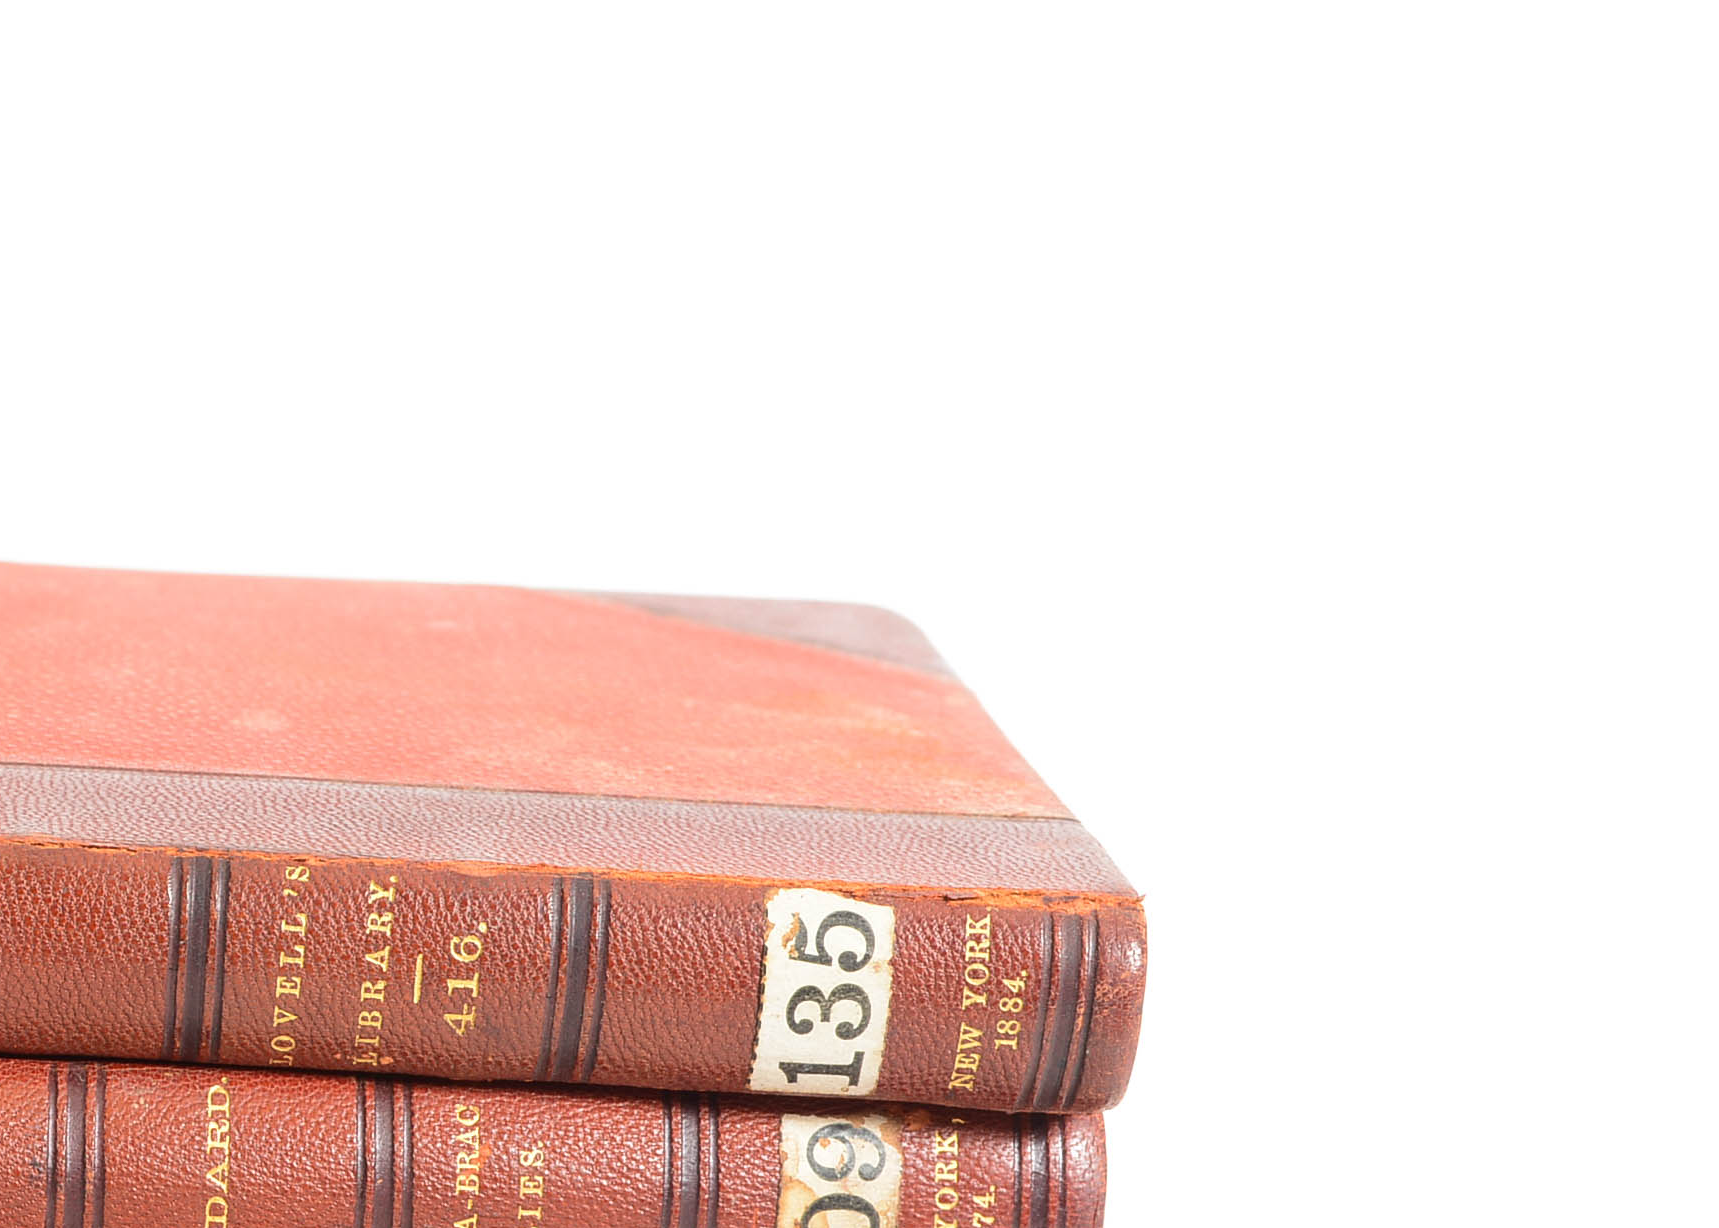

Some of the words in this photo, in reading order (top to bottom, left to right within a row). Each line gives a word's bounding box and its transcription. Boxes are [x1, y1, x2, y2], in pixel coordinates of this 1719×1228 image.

[268, 865, 310, 1067] LOVELL'S
[352, 875, 399, 1067] LIBRARY.
[443, 921, 488, 1036] 416.
[778, 910, 876, 1087] 135
[994, 969, 1028, 1052] 1884.
[948, 1021, 983, 1092] NEW
